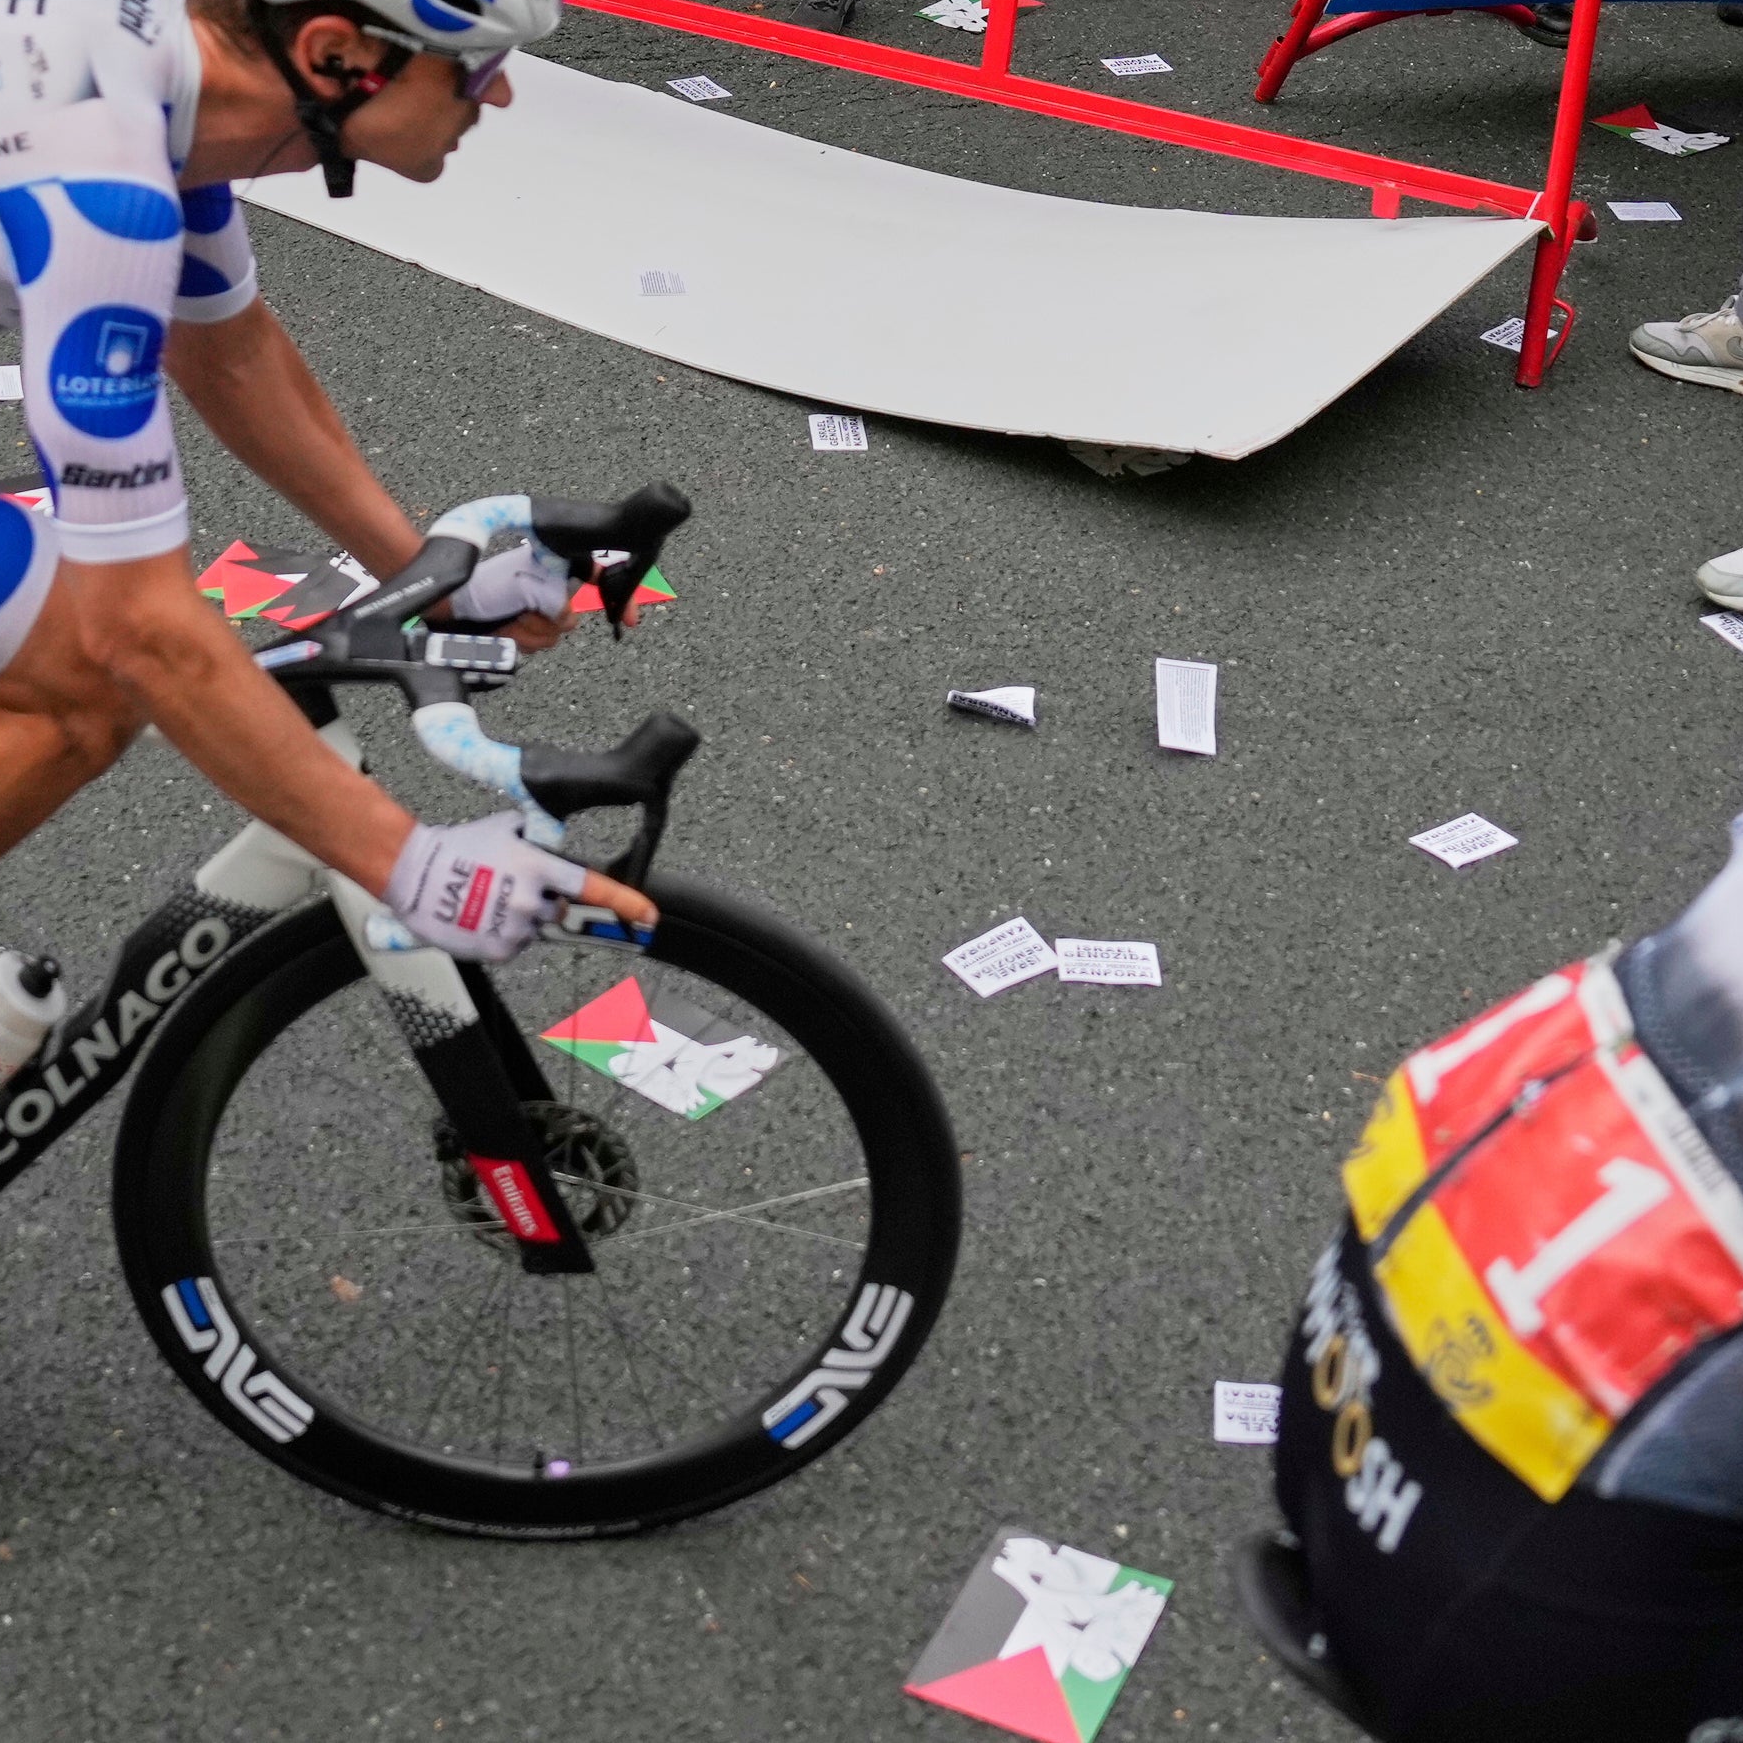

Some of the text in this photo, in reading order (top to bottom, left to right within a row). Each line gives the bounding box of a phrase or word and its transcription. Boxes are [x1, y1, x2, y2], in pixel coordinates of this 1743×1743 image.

[1077, 944, 1132, 953] ISRAEL
[1065, 950, 1150, 961] GENOZIDA
[1066, 968, 1154, 978] KANPORA!
[492, 1164, 538, 1236] Emirates
[1485, 1152, 1673, 1335] 1
